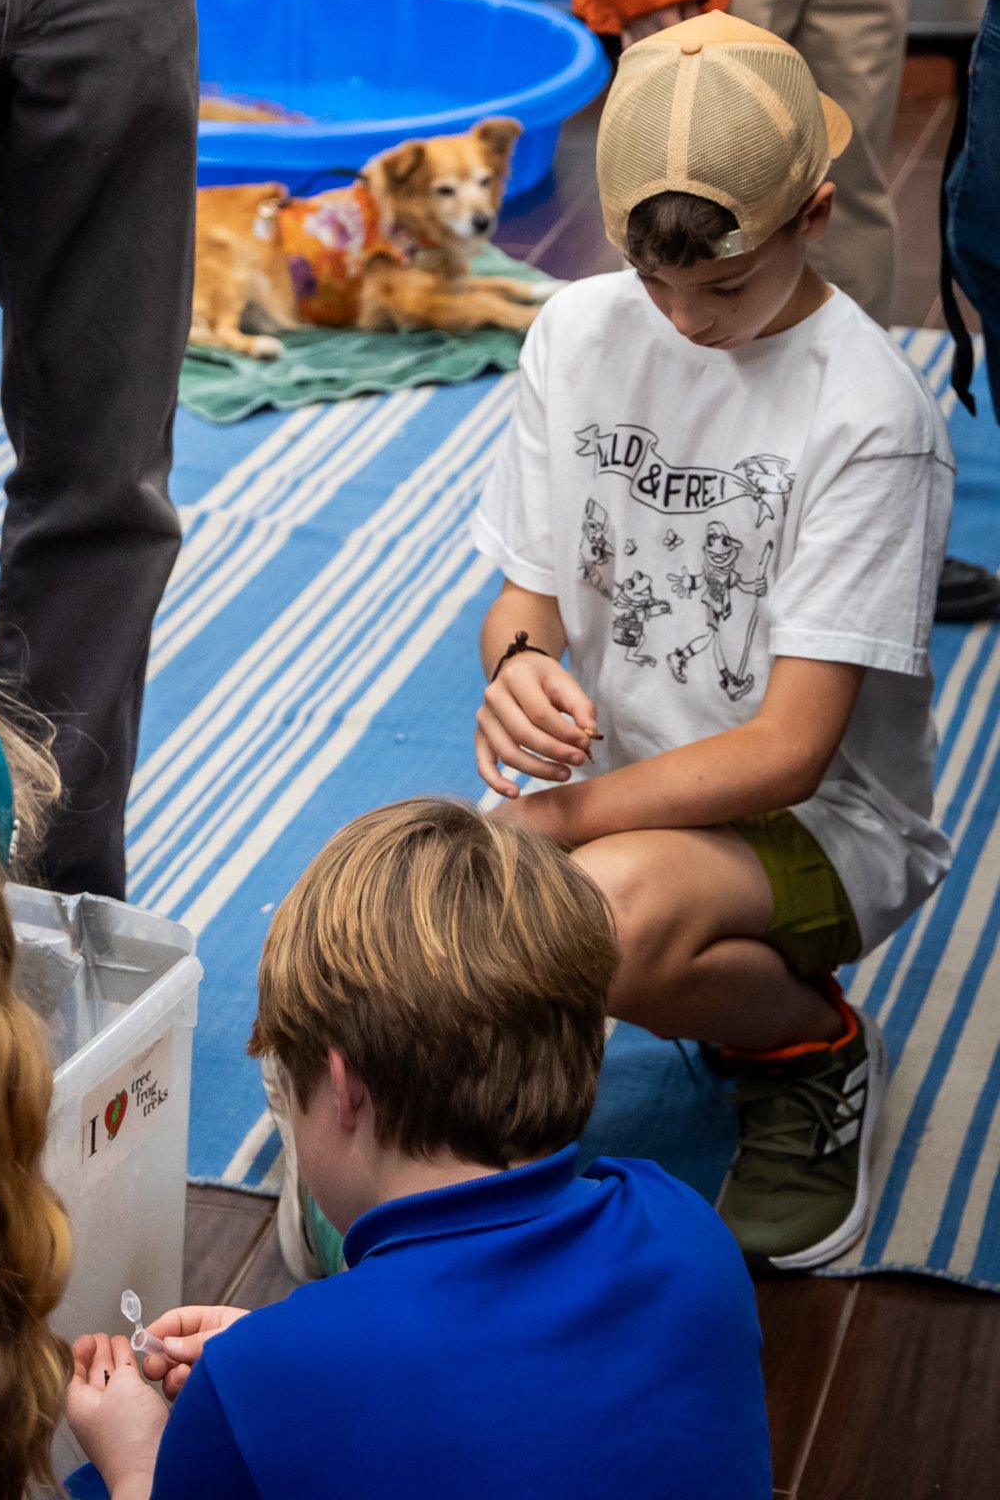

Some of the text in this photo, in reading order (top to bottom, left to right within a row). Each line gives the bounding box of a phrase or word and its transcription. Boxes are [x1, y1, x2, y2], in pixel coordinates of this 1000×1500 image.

[131, 1069, 152, 1094] tree
[136, 1079, 158, 1107] frog
[143, 1088, 168, 1117] treks
[88, 1114, 99, 1158] I
